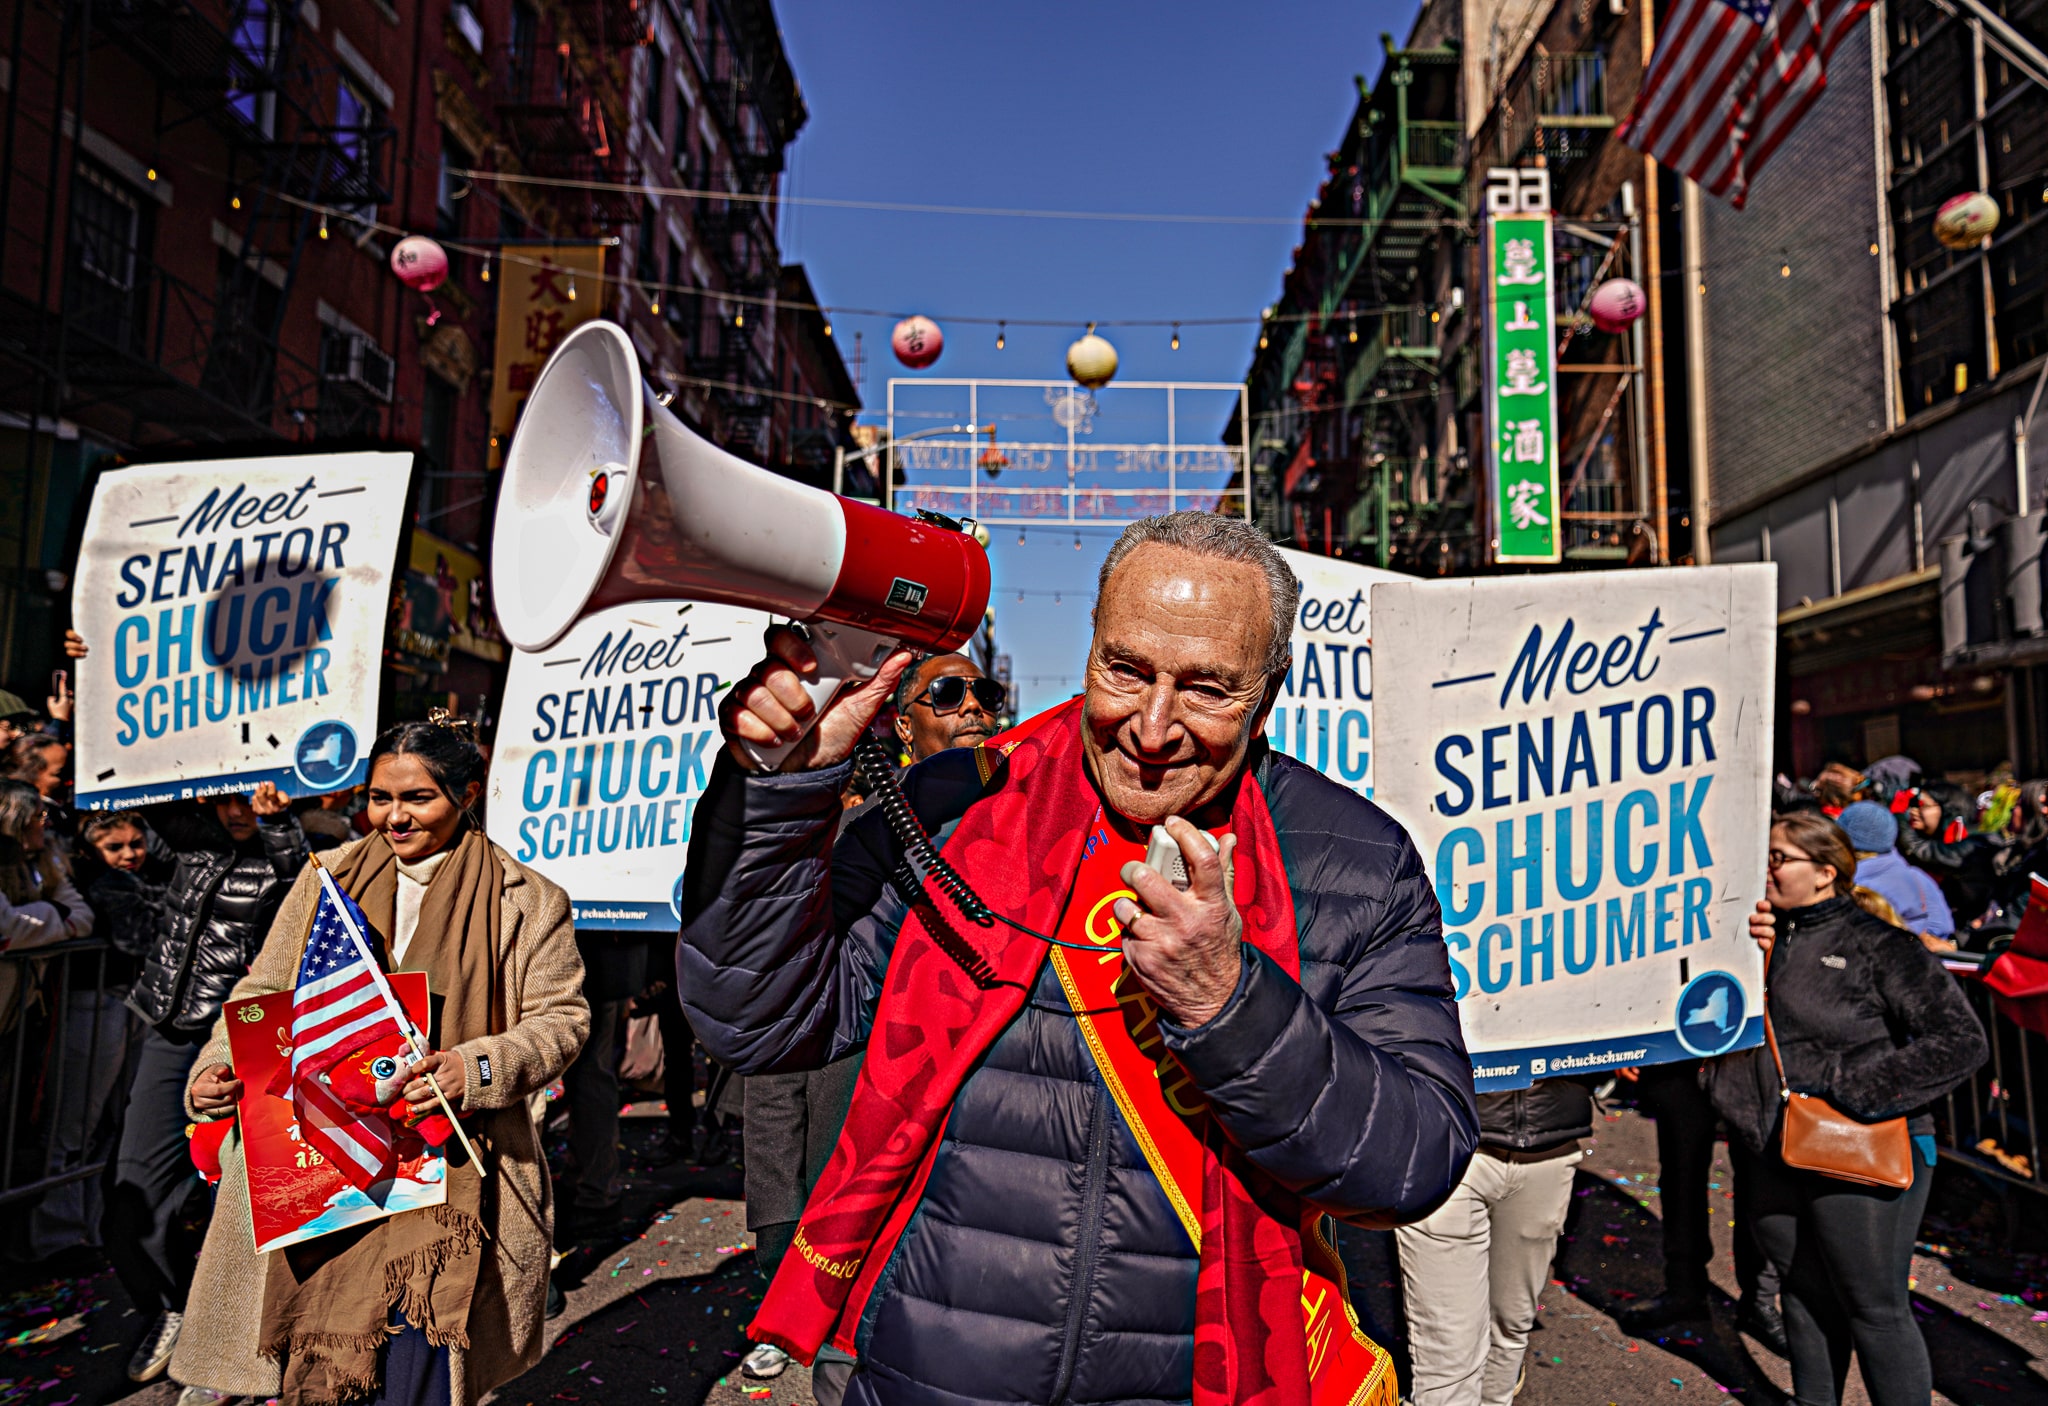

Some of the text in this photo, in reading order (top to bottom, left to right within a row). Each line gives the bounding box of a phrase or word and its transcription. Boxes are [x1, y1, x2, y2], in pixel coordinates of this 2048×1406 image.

[177, 476, 316, 538] Meet
[116, 522, 350, 608] SENATOR
[114, 577, 341, 689] CHUCK
[1297, 581, 1364, 634] eet
[581, 624, 691, 680] Meet
[1500, 607, 1665, 709] Meet
[116, 648, 331, 746] SCHUMER
[532, 673, 720, 743] SENATOR
[522, 730, 714, 812] CHUCK
[1434, 687, 1718, 817] SENATOR
[1435, 774, 1715, 927] CHUCK
[581, 908, 648, 921] @chuckschumer
[1444, 877, 1713, 1003] SCHUMER
[479, 1060, 491, 1079] DKNY
[1550, 1048, 1647, 1071] @chuckschumer
